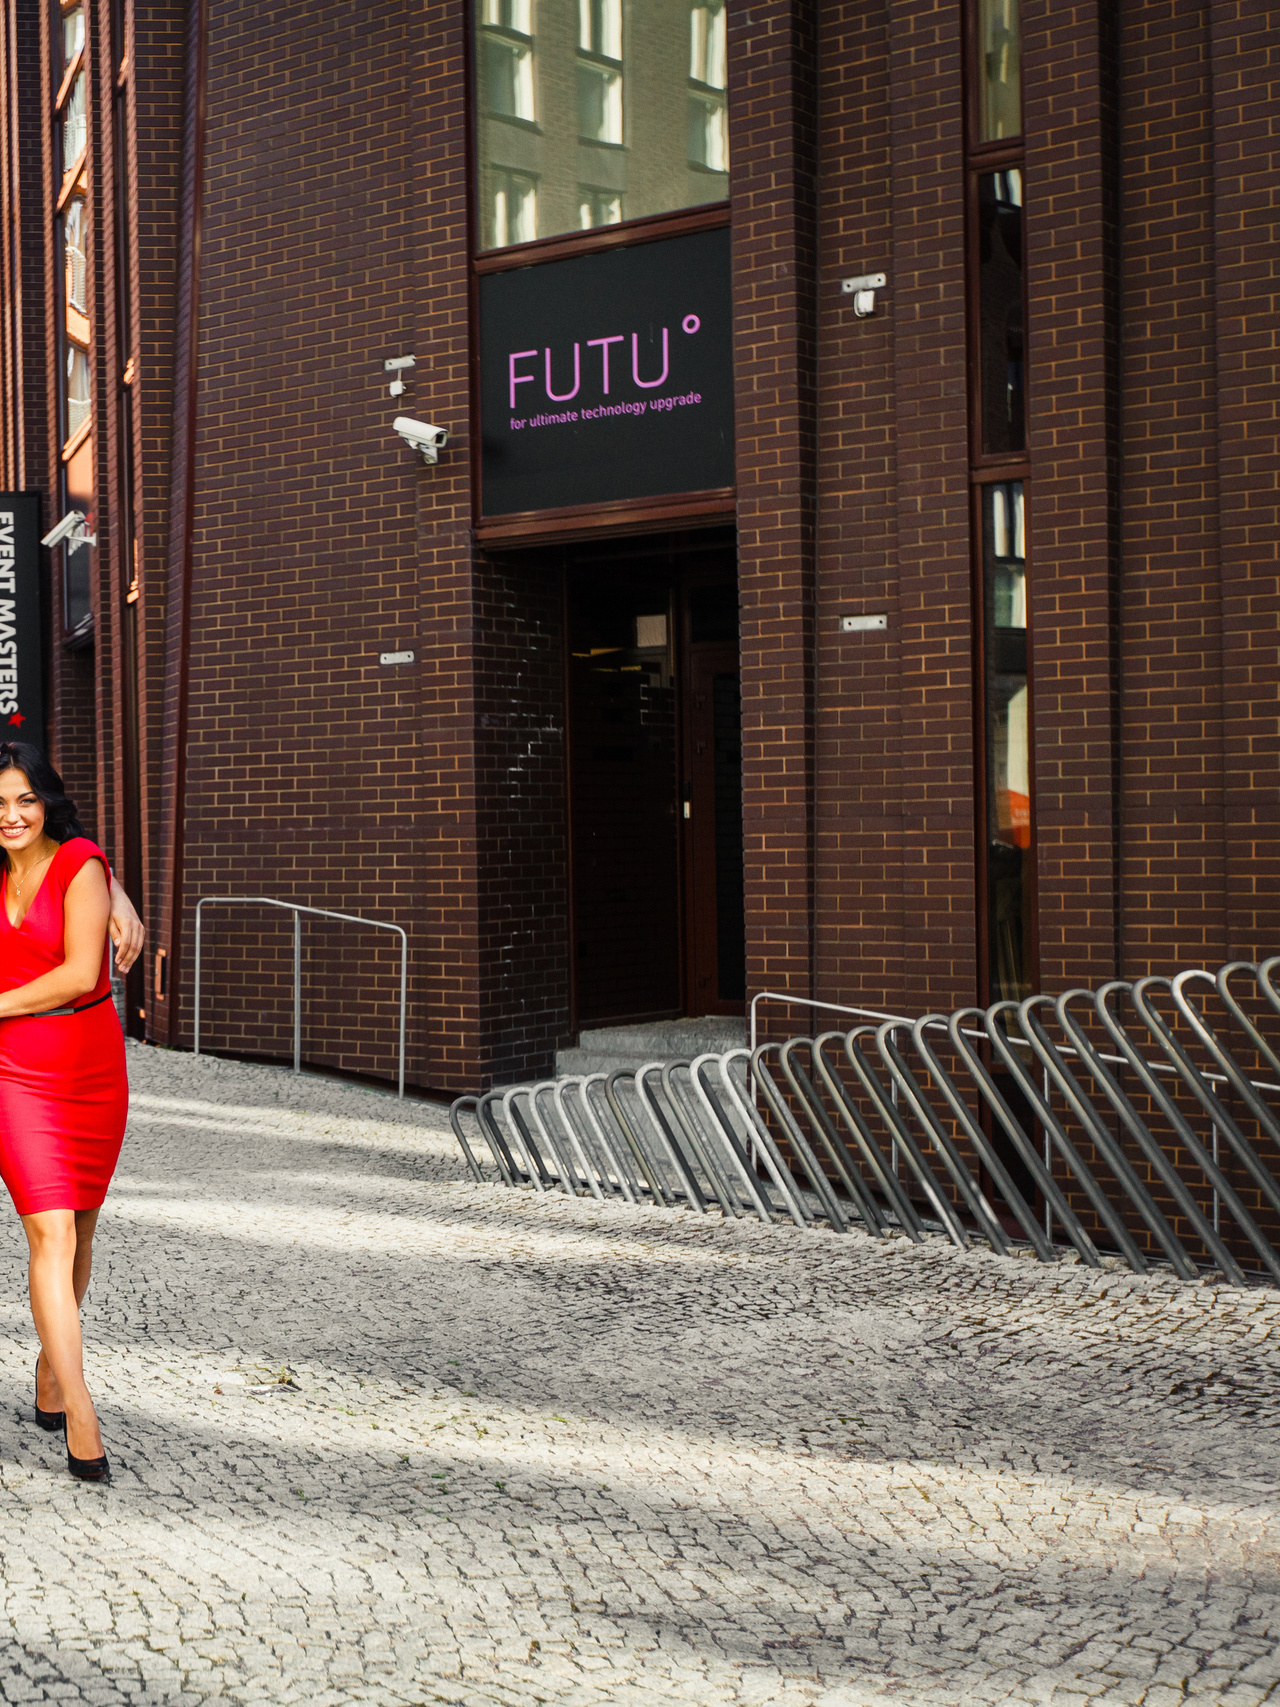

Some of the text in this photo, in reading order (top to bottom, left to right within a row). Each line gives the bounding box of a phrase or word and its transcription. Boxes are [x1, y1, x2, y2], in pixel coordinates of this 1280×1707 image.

[510, 391, 702, 430] for ultimate technology upgrade
